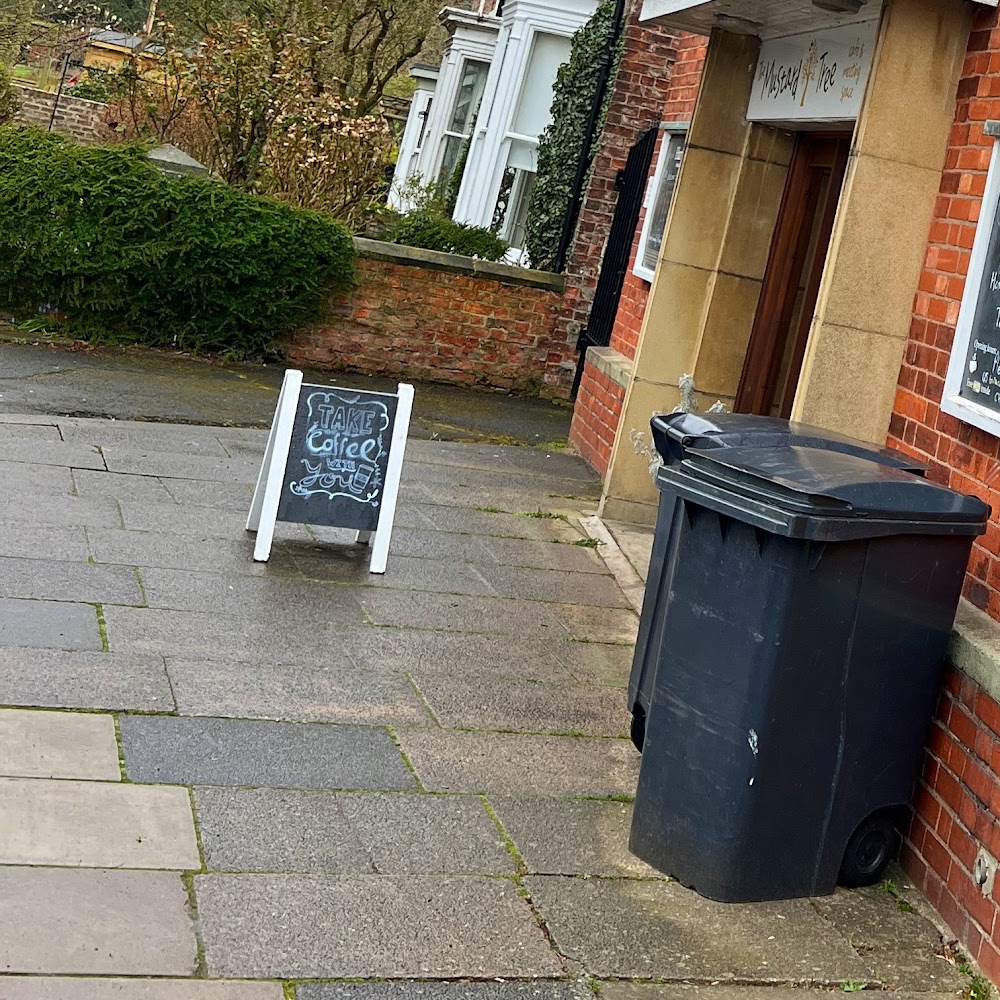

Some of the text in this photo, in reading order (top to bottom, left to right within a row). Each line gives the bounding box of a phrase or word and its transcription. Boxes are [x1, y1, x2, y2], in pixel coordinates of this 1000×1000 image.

[761, 59, 802, 101] Mustard
[816, 51, 837, 93] Tree
[318, 404, 376, 435] TAKE
[306, 430, 376, 463] Coffee
